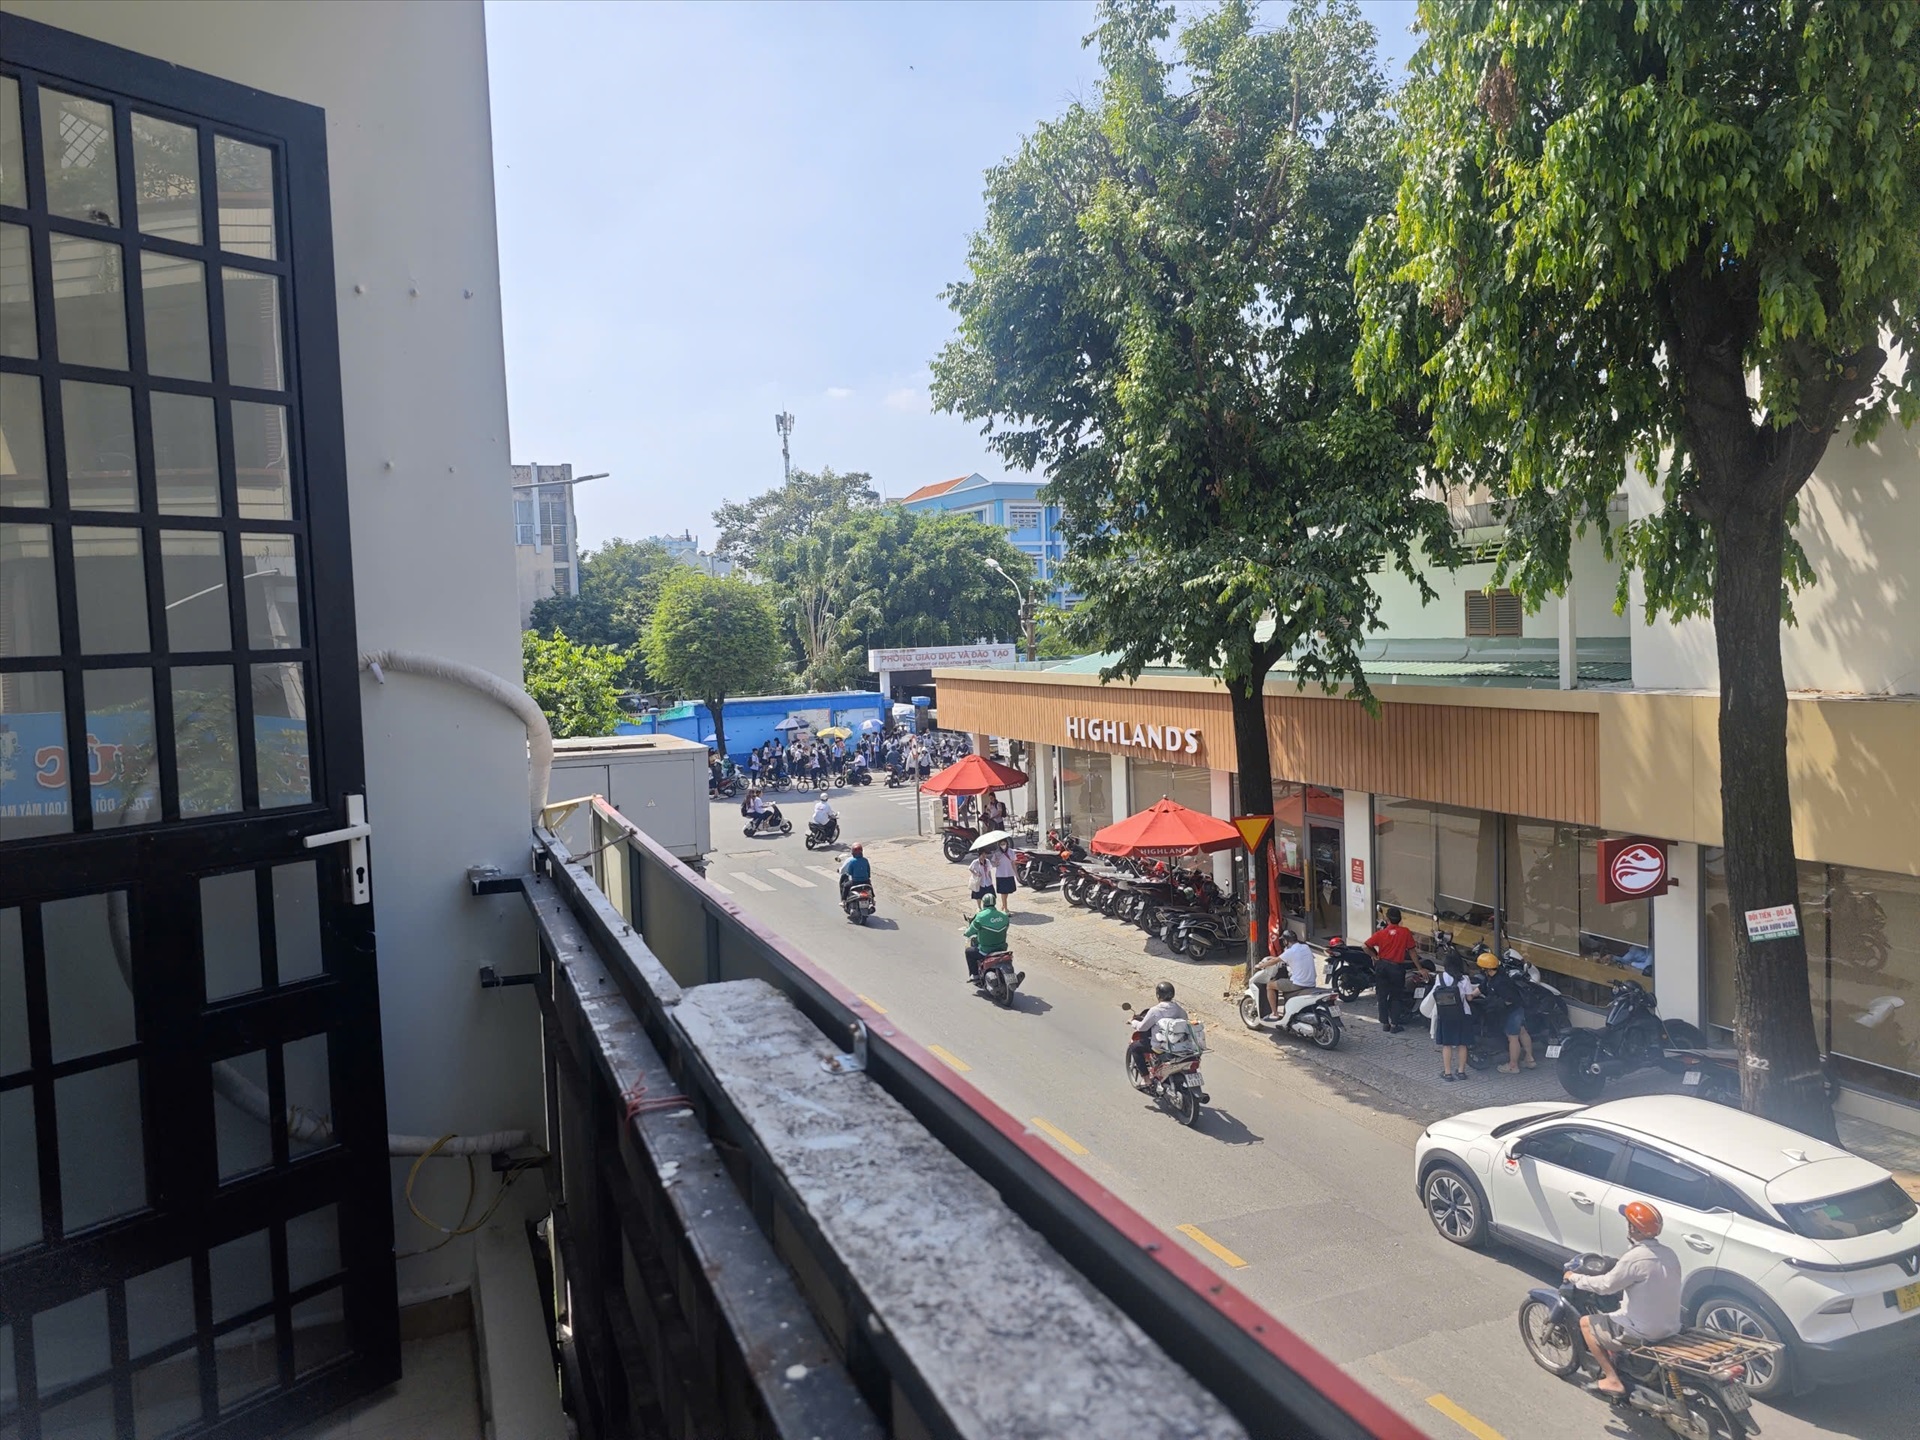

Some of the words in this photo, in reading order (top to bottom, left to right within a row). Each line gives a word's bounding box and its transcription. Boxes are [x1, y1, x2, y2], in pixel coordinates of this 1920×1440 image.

[881, 653, 912, 662] PHÒNG
[915, 652, 936, 661] GIÁO
[939, 651, 956, 660] DỤC
[957, 650, 970, 659] VÀ
[971, 649, 989, 658] ĐÀO
[992, 649, 1009, 658] TẠO
[1066, 716, 1199, 754] HIGHLANDS
